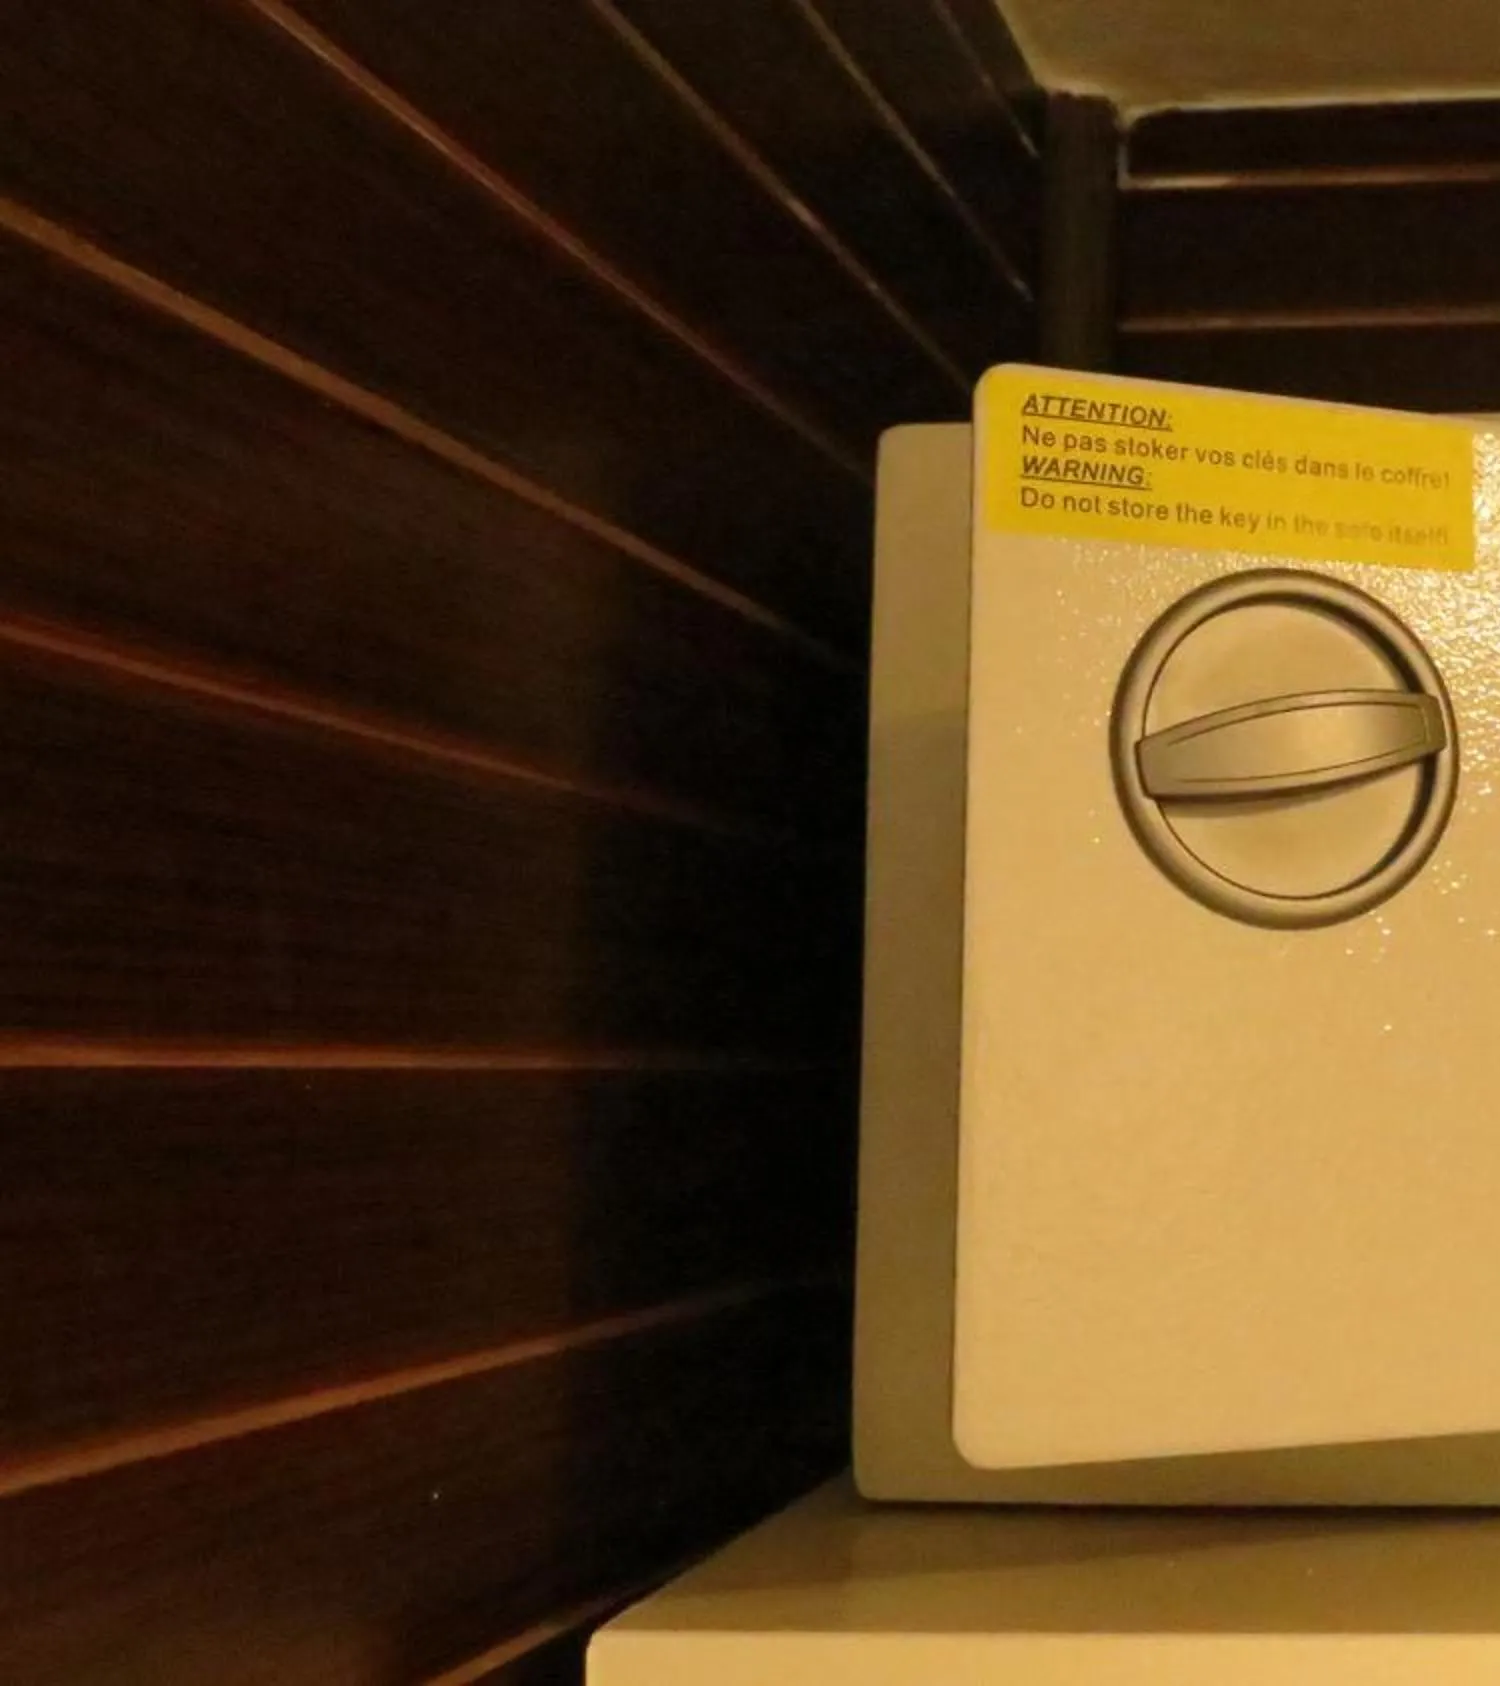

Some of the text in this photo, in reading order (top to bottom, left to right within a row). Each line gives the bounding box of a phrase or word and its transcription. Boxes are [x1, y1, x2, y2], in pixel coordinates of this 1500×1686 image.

[1022, 393, 1173, 431] ATTENTION:
[1021, 454, 1152, 490] WARNING:
[1022, 425, 1056, 448] Ne
[1063, 433, 1107, 453] pas
[1115, 436, 1188, 461] stoker
[1195, 447, 1235, 467] vos
[1295, 455, 1349, 480] dans
[1355, 462, 1374, 481] le
[1021, 486, 1055, 509] Do
[1063, 494, 1101, 514] not
[1108, 497, 1169, 520] store
[1176, 502, 1213, 524] the
[1220, 506, 1261, 534] key
[1267, 512, 1286, 531] in
[1292, 514, 1328, 536] the
